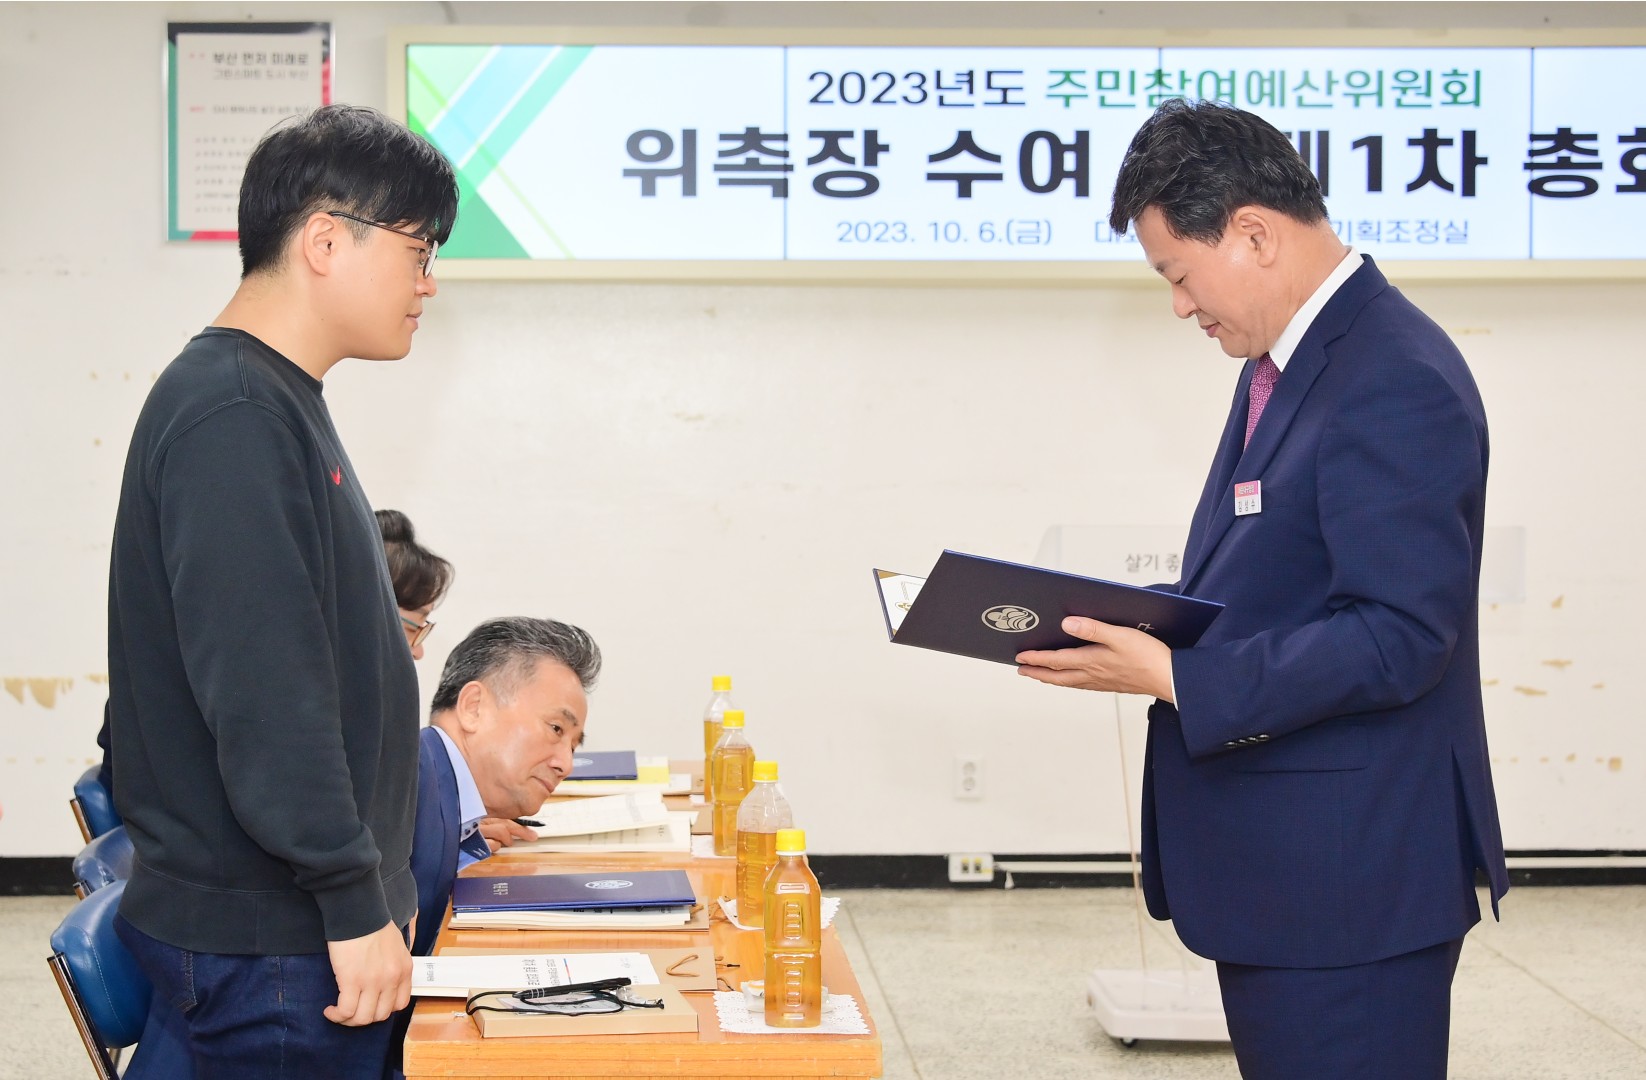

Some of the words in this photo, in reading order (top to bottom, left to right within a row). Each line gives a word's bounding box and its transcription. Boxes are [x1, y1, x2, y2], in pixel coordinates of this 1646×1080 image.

[213, 51, 238, 66] 부산
[808, 69, 1027, 108] 2023년도
[1046, 68, 1482, 108] 주민참여예산위원회
[622, 126, 890, 199] 위촉장
[926, 129, 1091, 199] 수여
[836, 220, 916, 244] 2023.
[928, 220, 969, 244] 10.
[978, 218, 1053, 246] 6.(금)
[1331, 219, 1469, 245] 기획조정실
[1124, 553, 1159, 573] 살기
